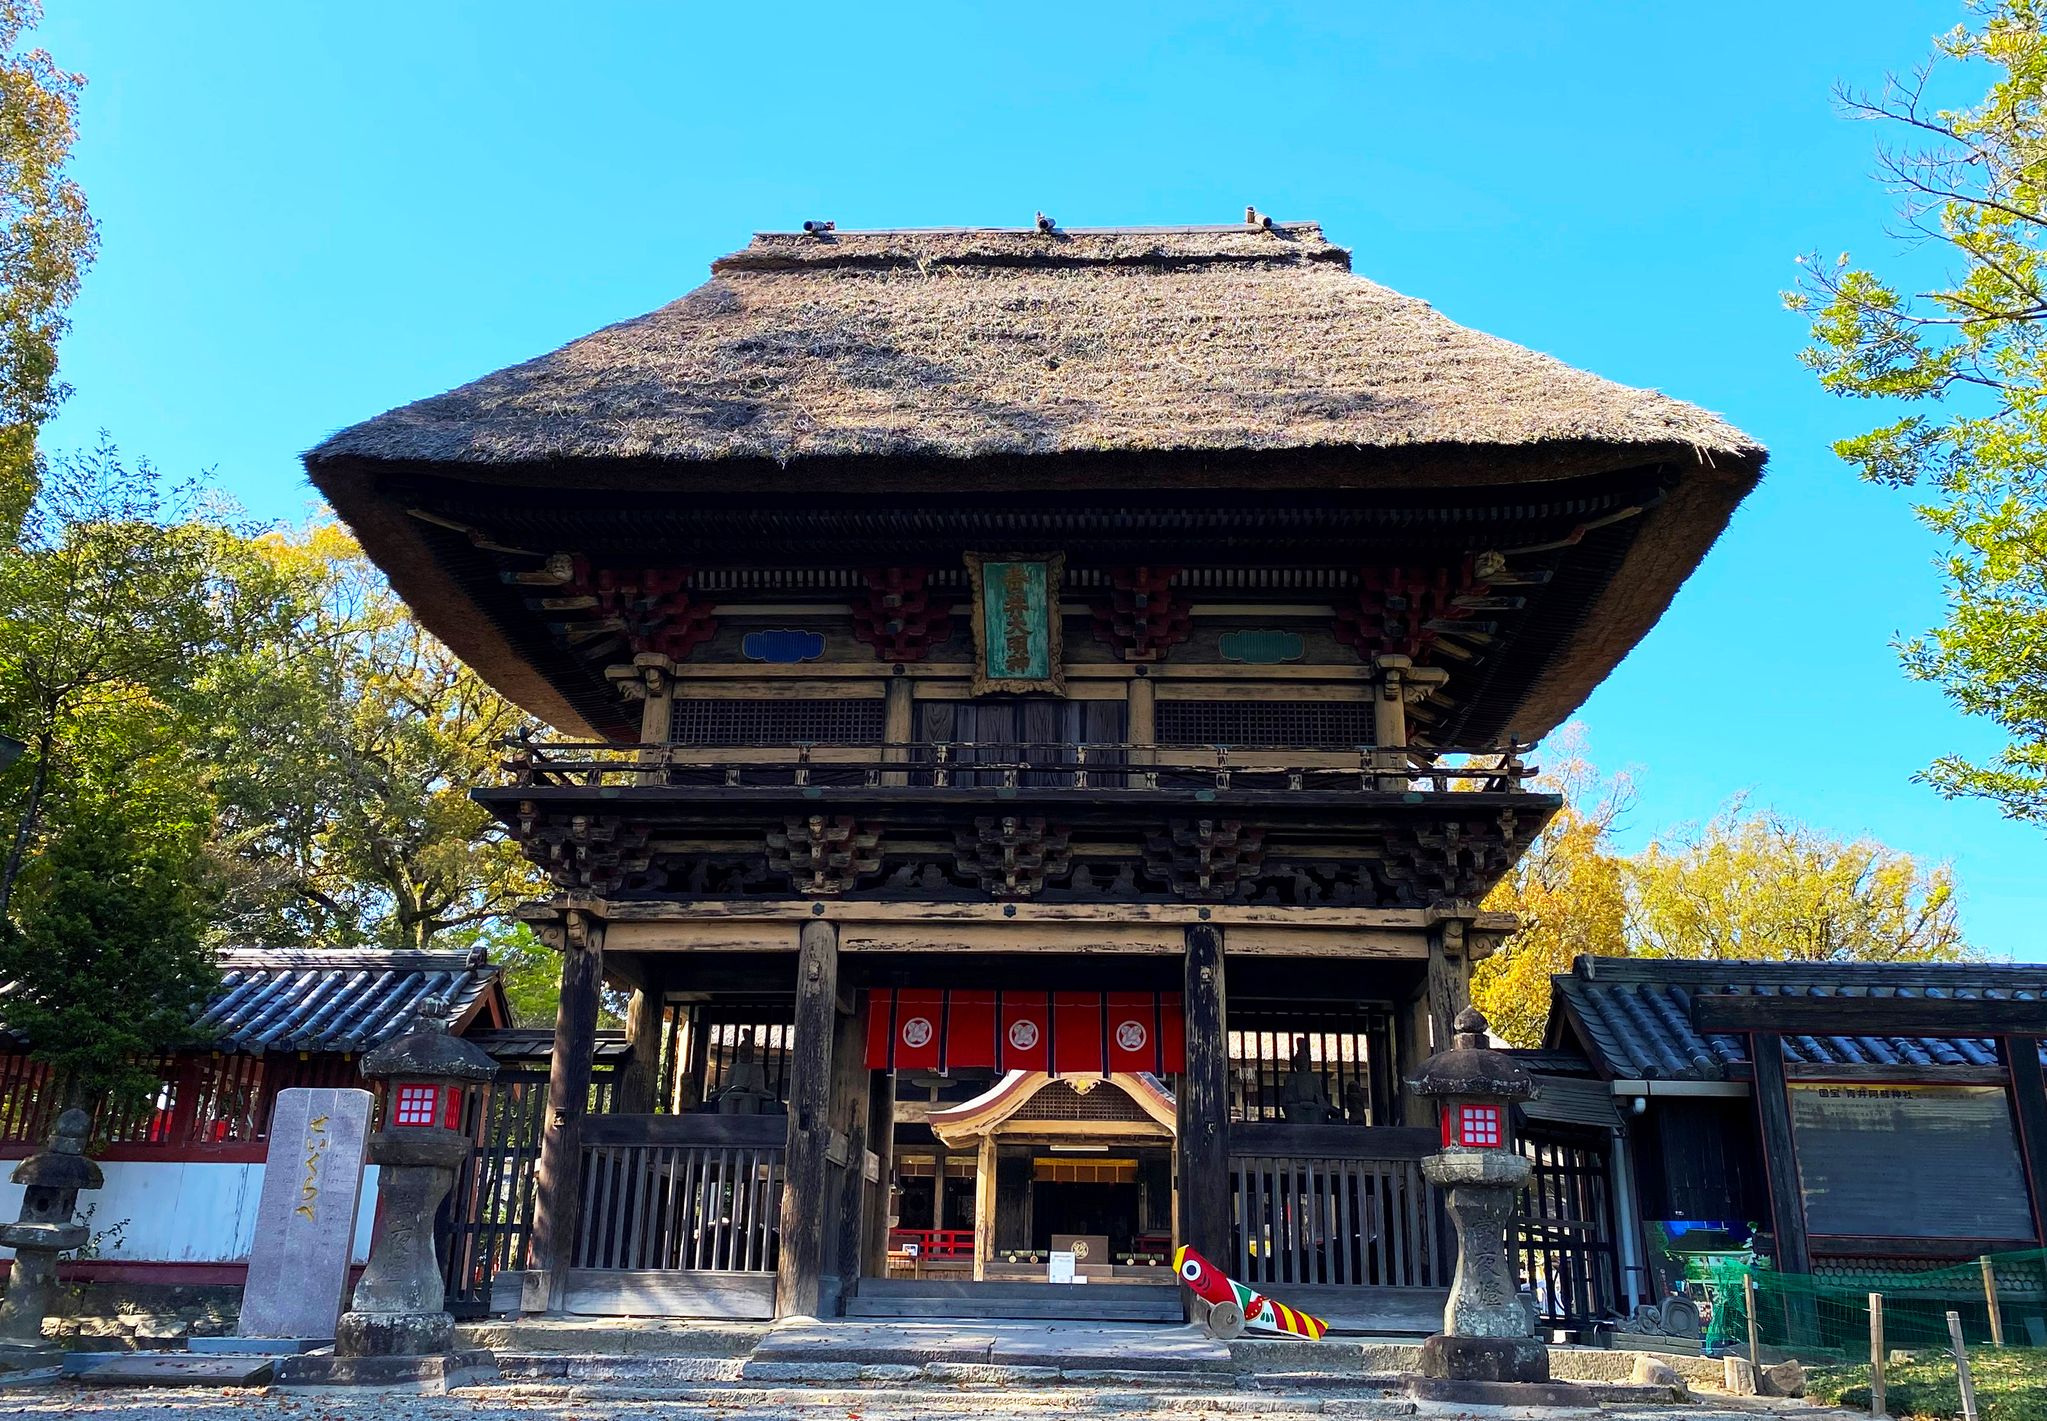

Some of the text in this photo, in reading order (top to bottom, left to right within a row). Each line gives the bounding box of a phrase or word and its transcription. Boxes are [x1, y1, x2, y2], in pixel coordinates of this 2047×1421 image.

[1003, 564, 1032, 673] 青井大明神
[1818, 1088, 1841, 1098] 国宝
[295, 1112, 330, 1223] せいくらべ
